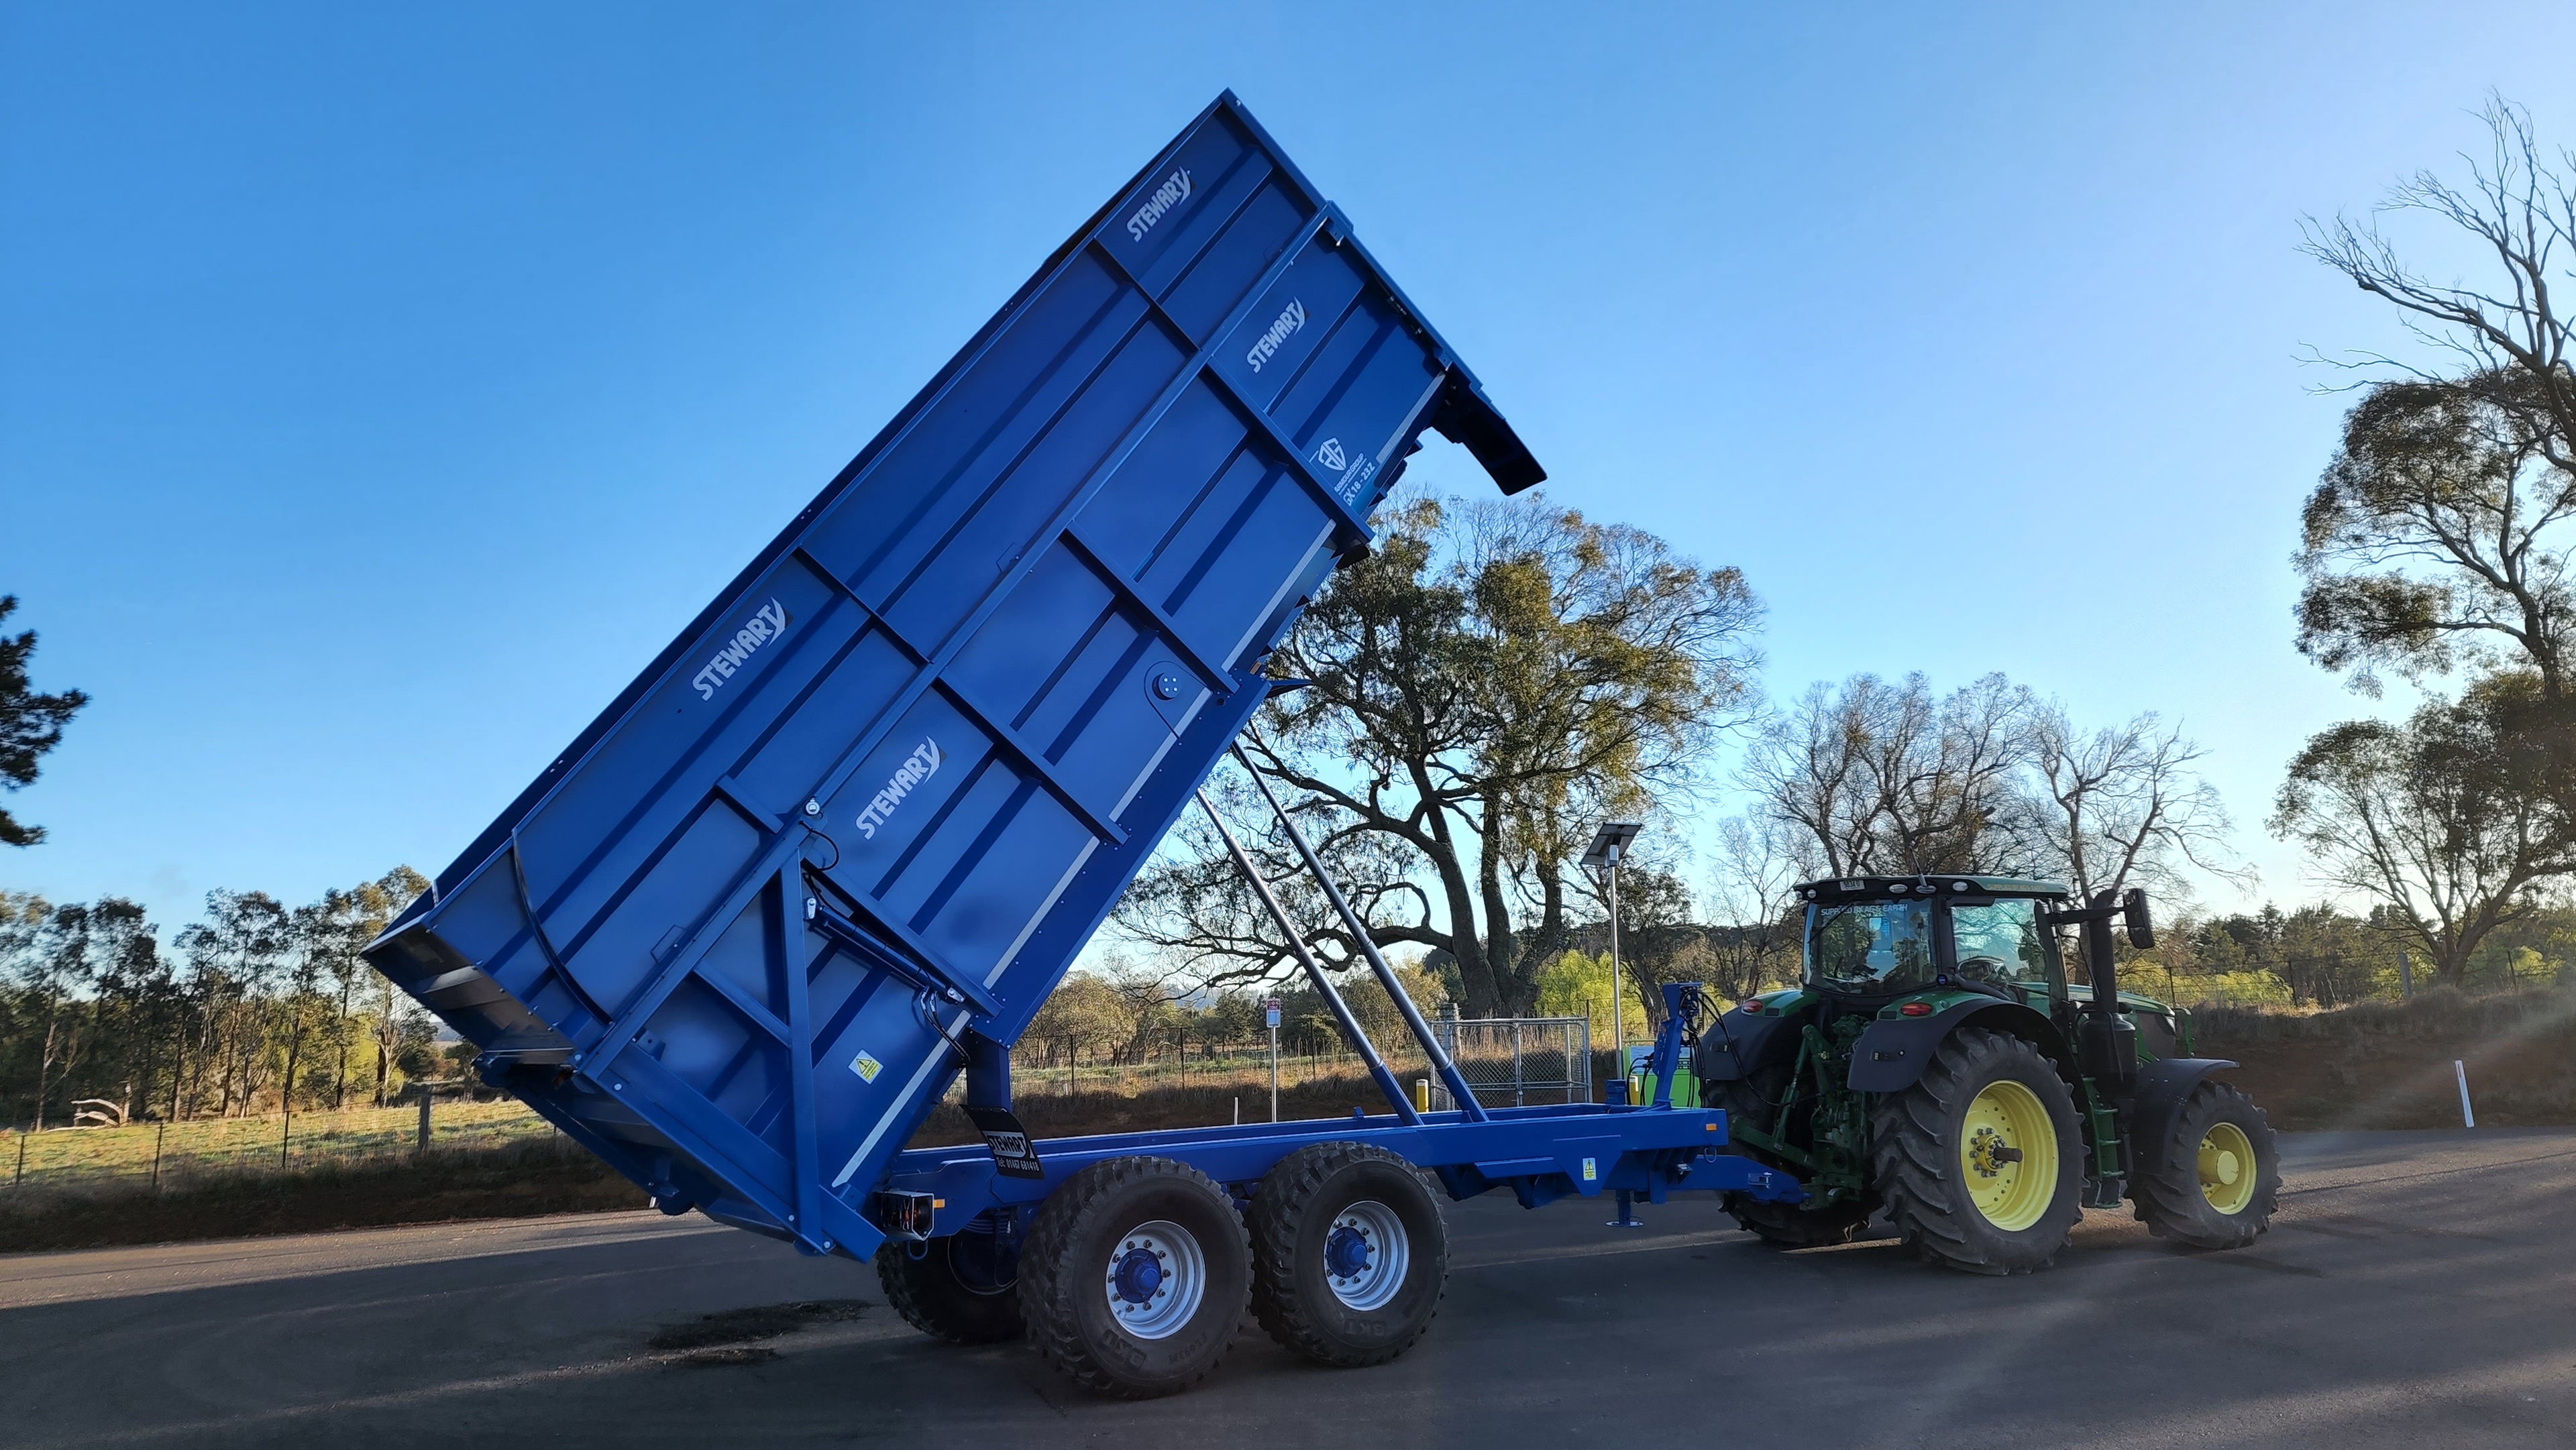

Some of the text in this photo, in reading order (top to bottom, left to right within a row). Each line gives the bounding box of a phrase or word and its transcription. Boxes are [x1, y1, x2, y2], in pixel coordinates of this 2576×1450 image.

[1126, 166, 1191, 242] STEWART
[1247, 296, 1305, 374] STEWART
[1350, 453, 1364, 472] GROUP
[692, 596, 786, 702] STEWART
[856, 734, 941, 840] STEWART
[1882, 904, 1908, 912] EARTH
[986, 1134, 1027, 1153] STEWART
